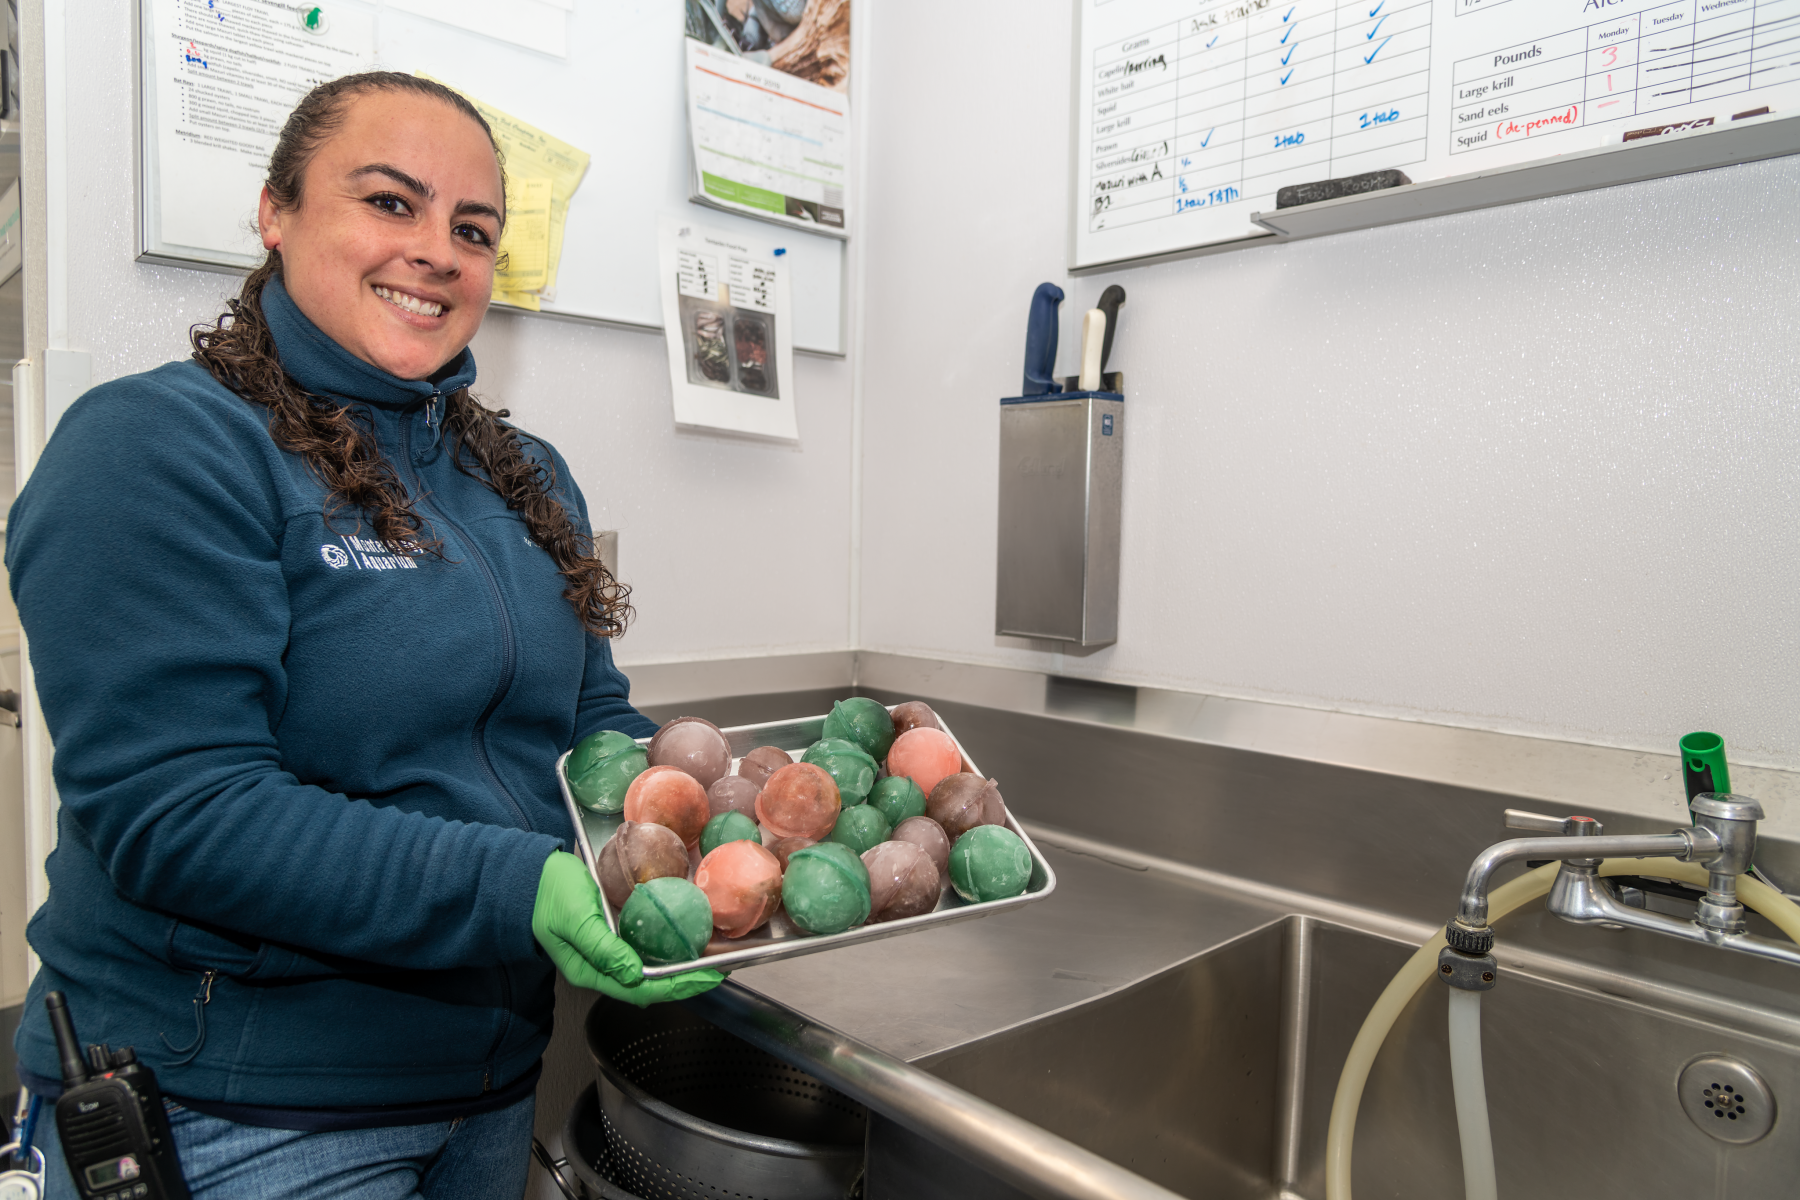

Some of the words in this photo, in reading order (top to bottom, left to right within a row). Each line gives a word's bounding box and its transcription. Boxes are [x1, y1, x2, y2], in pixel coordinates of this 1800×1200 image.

[1652, 12, 1685, 25] Tuesday
[1598, 26, 1630, 40] Monday
[1493, 45, 1542, 67] Pounds
[1602, 46, 1618, 67] 3
[745, 72, 762, 83] MAY
[1459, 85, 1488, 99] Large
[1492, 76, 1514, 91] krill
[1097, 102, 1117, 116] Squid
[1458, 108, 1484, 123] Sand
[1488, 103, 1509, 117] eels
[1457, 130, 1488, 147] Squid
[1151, 162, 1163, 181] A
[360, 551, 418, 572] Aquarium
